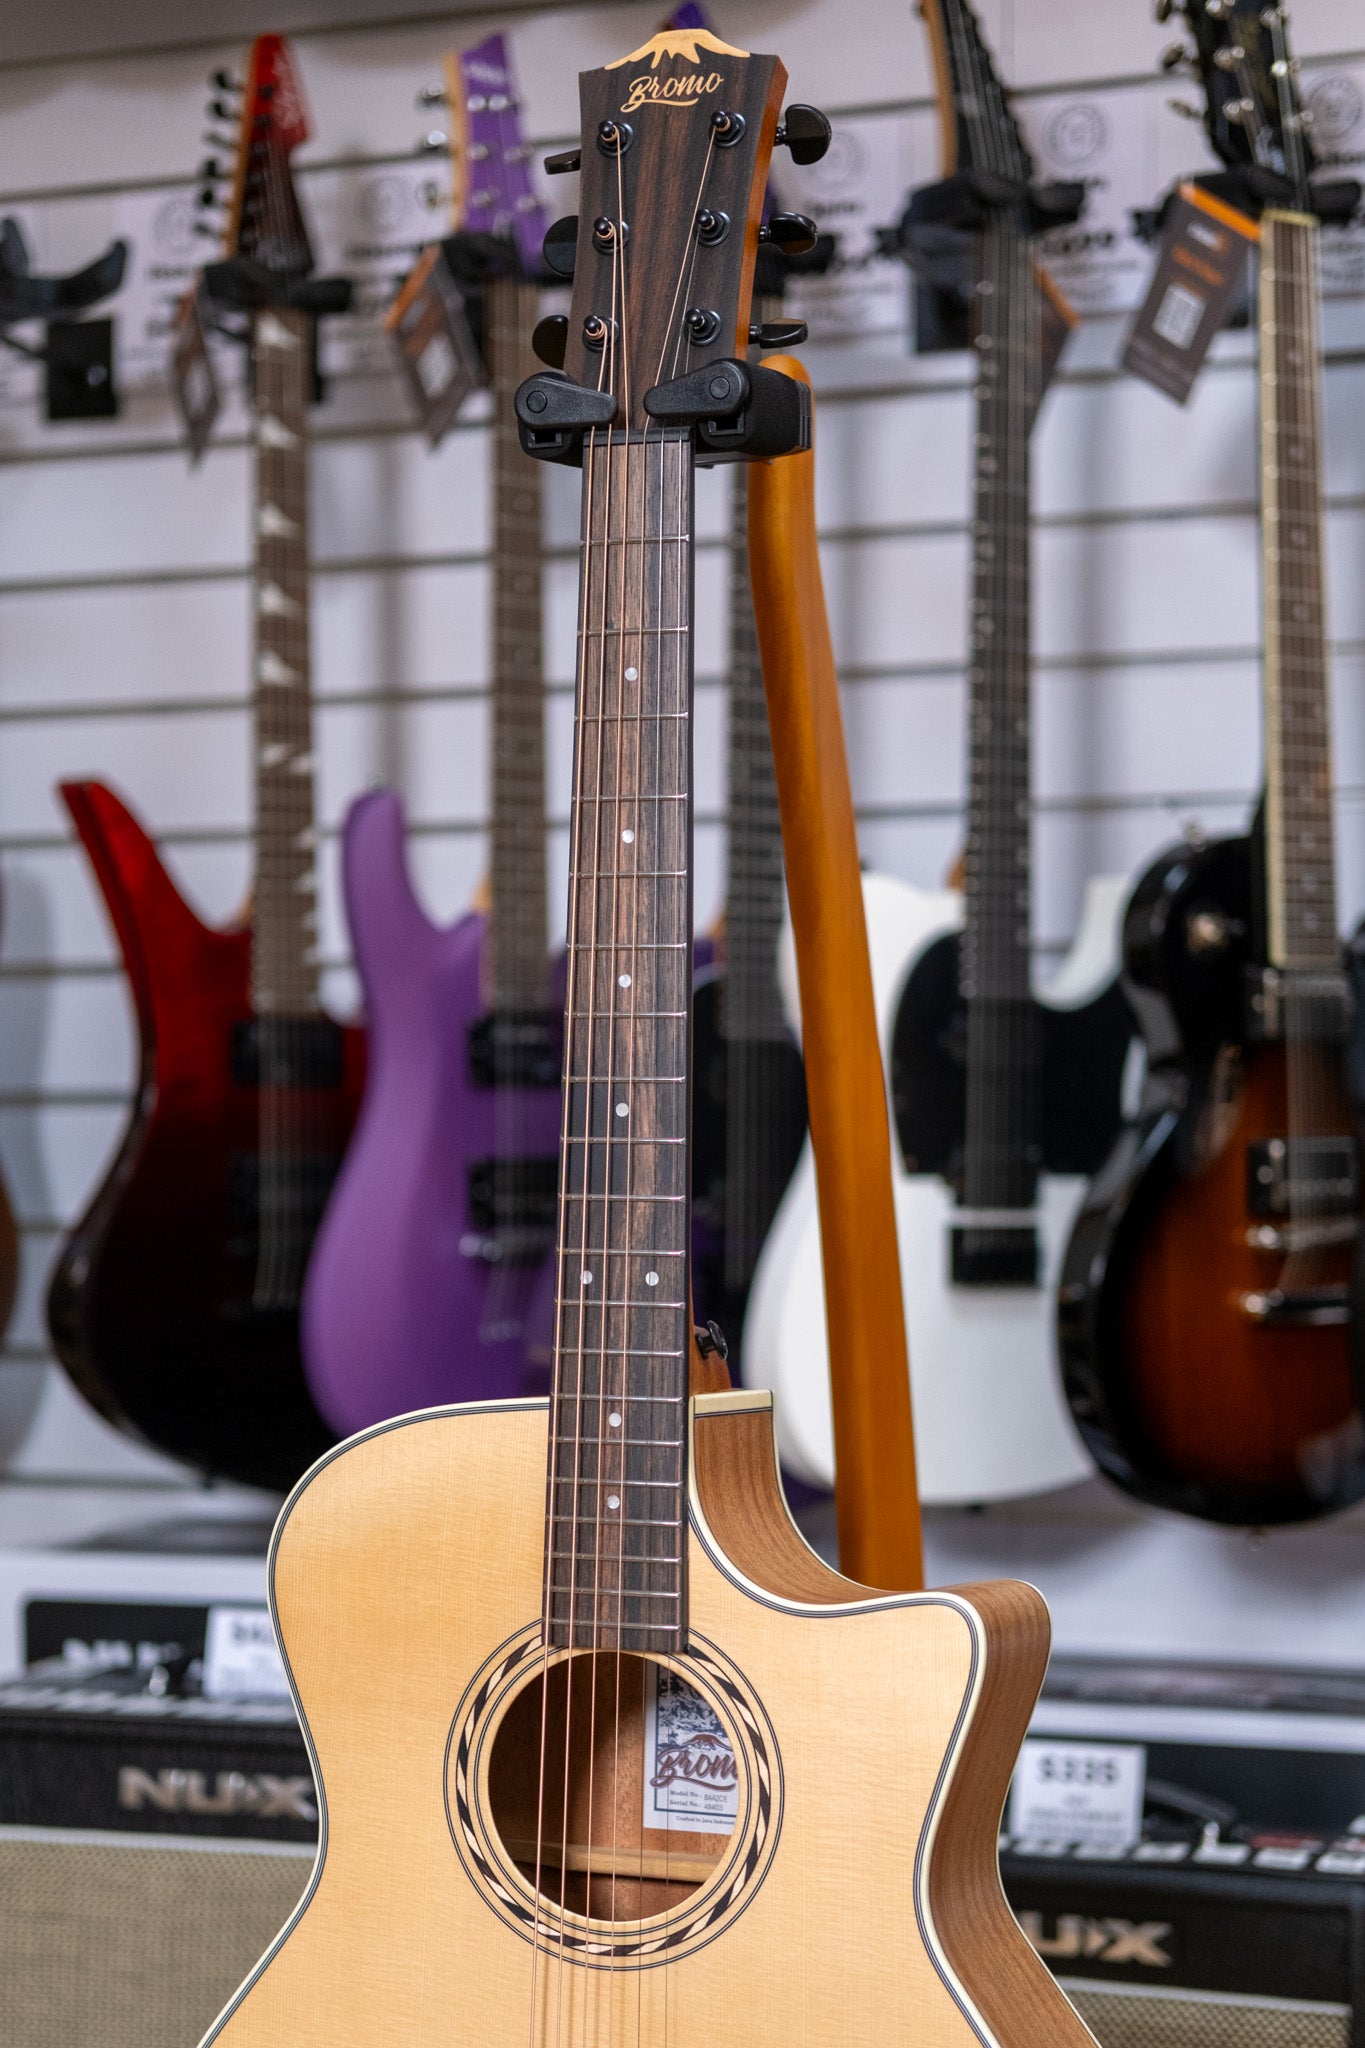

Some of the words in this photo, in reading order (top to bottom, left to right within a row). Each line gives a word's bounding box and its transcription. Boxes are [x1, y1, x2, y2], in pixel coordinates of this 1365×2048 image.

[620, 72, 724, 113] Bromo
[118, 1766, 319, 1822] NUX
[650, 1746, 739, 1792] Brom
[1014, 1910, 1174, 1968] UX
